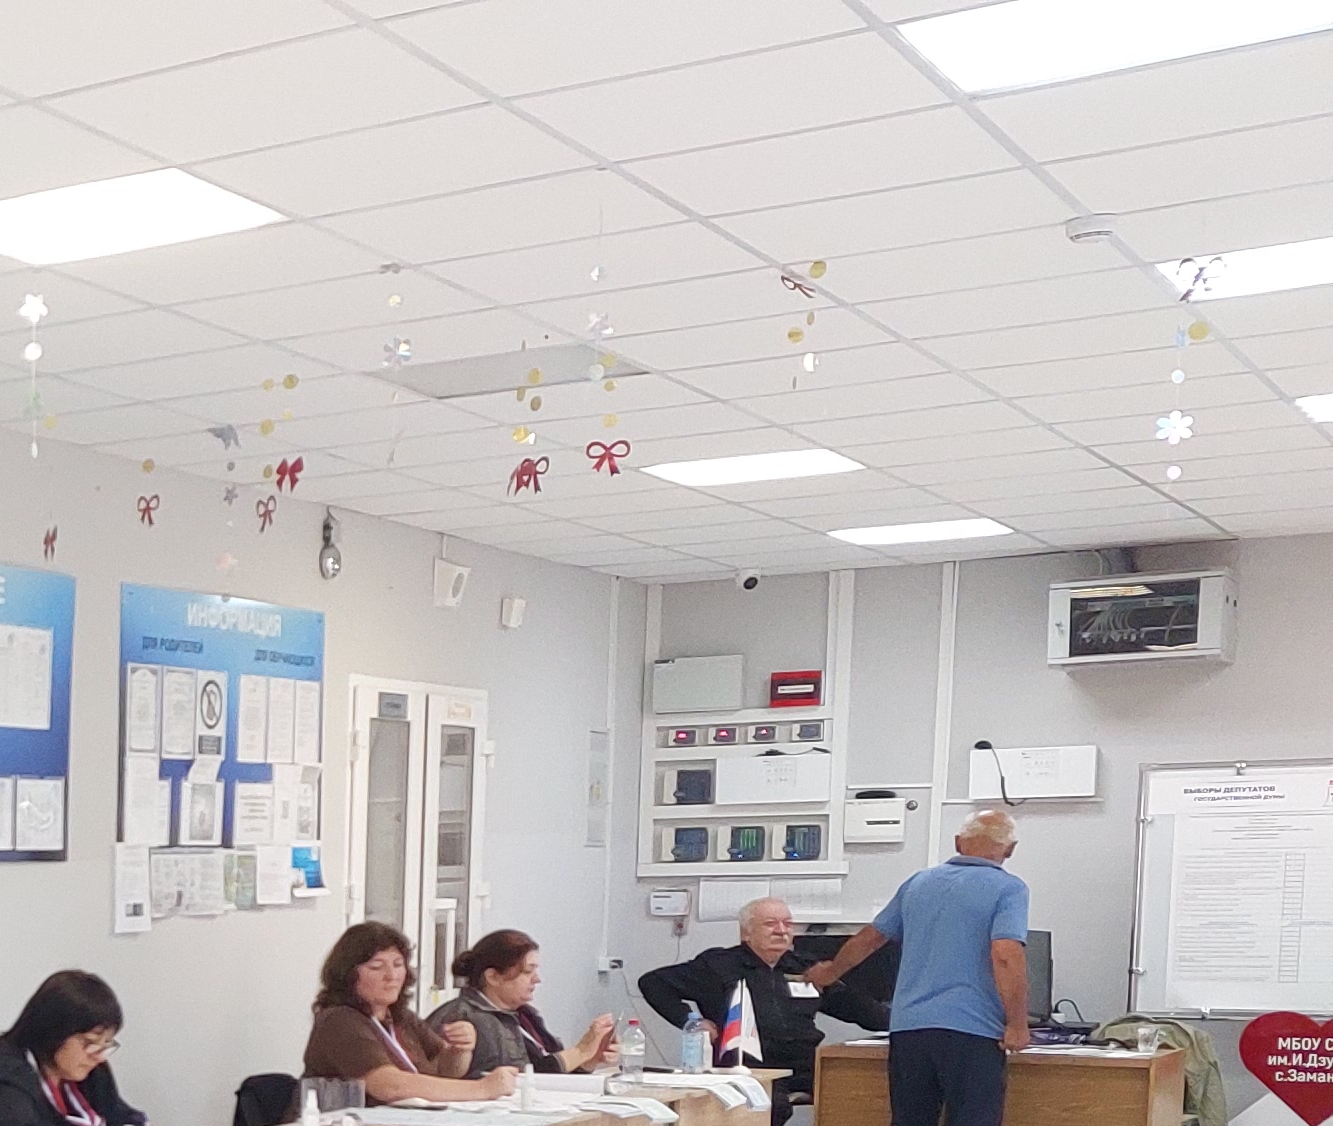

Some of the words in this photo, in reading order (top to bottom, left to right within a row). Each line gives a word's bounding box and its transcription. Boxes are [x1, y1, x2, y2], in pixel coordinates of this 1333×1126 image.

[187, 602, 282, 638] ИНФОРМАЦИЯ
[1183, 787, 1221, 795] ВЫБОРЫ
[1223, 785, 1276, 794] ДЕПУТАТОВ
[1277, 1037, 1321, 1050] МБОУ
